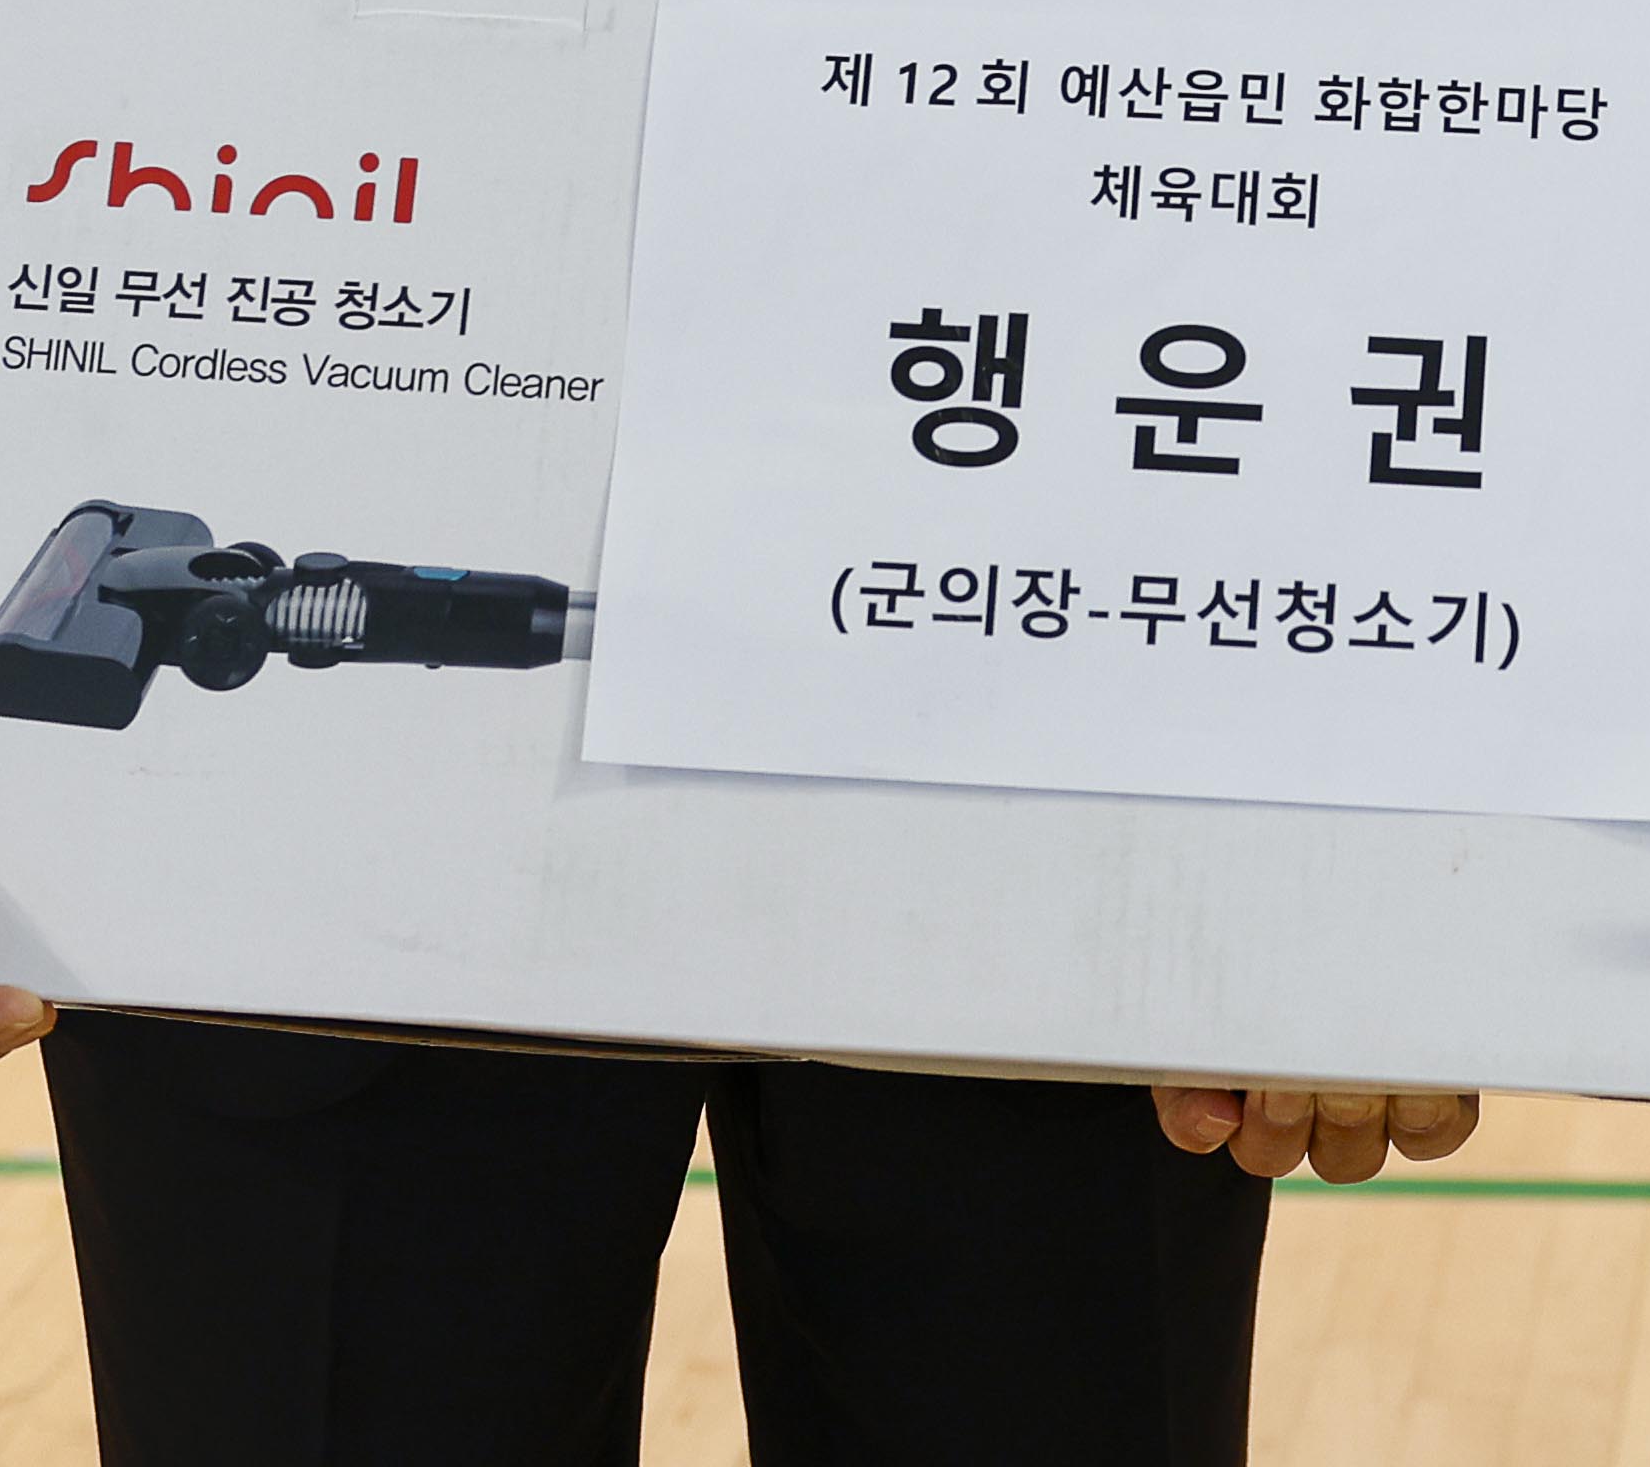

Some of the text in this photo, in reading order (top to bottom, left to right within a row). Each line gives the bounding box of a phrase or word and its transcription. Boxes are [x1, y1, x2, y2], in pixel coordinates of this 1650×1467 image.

[822, 54, 1607, 140] 제 12 회 예산읍민 화합한마당
[1091, 165, 1318, 228] 체육대회
[9, 264, 470, 335] 신일 무선 진공 청소기
[3, 336, 604, 401] SHINIL Cordless Vacuum Cleaner
[832, 562, 1519, 670] (군의장-무선청소기)
